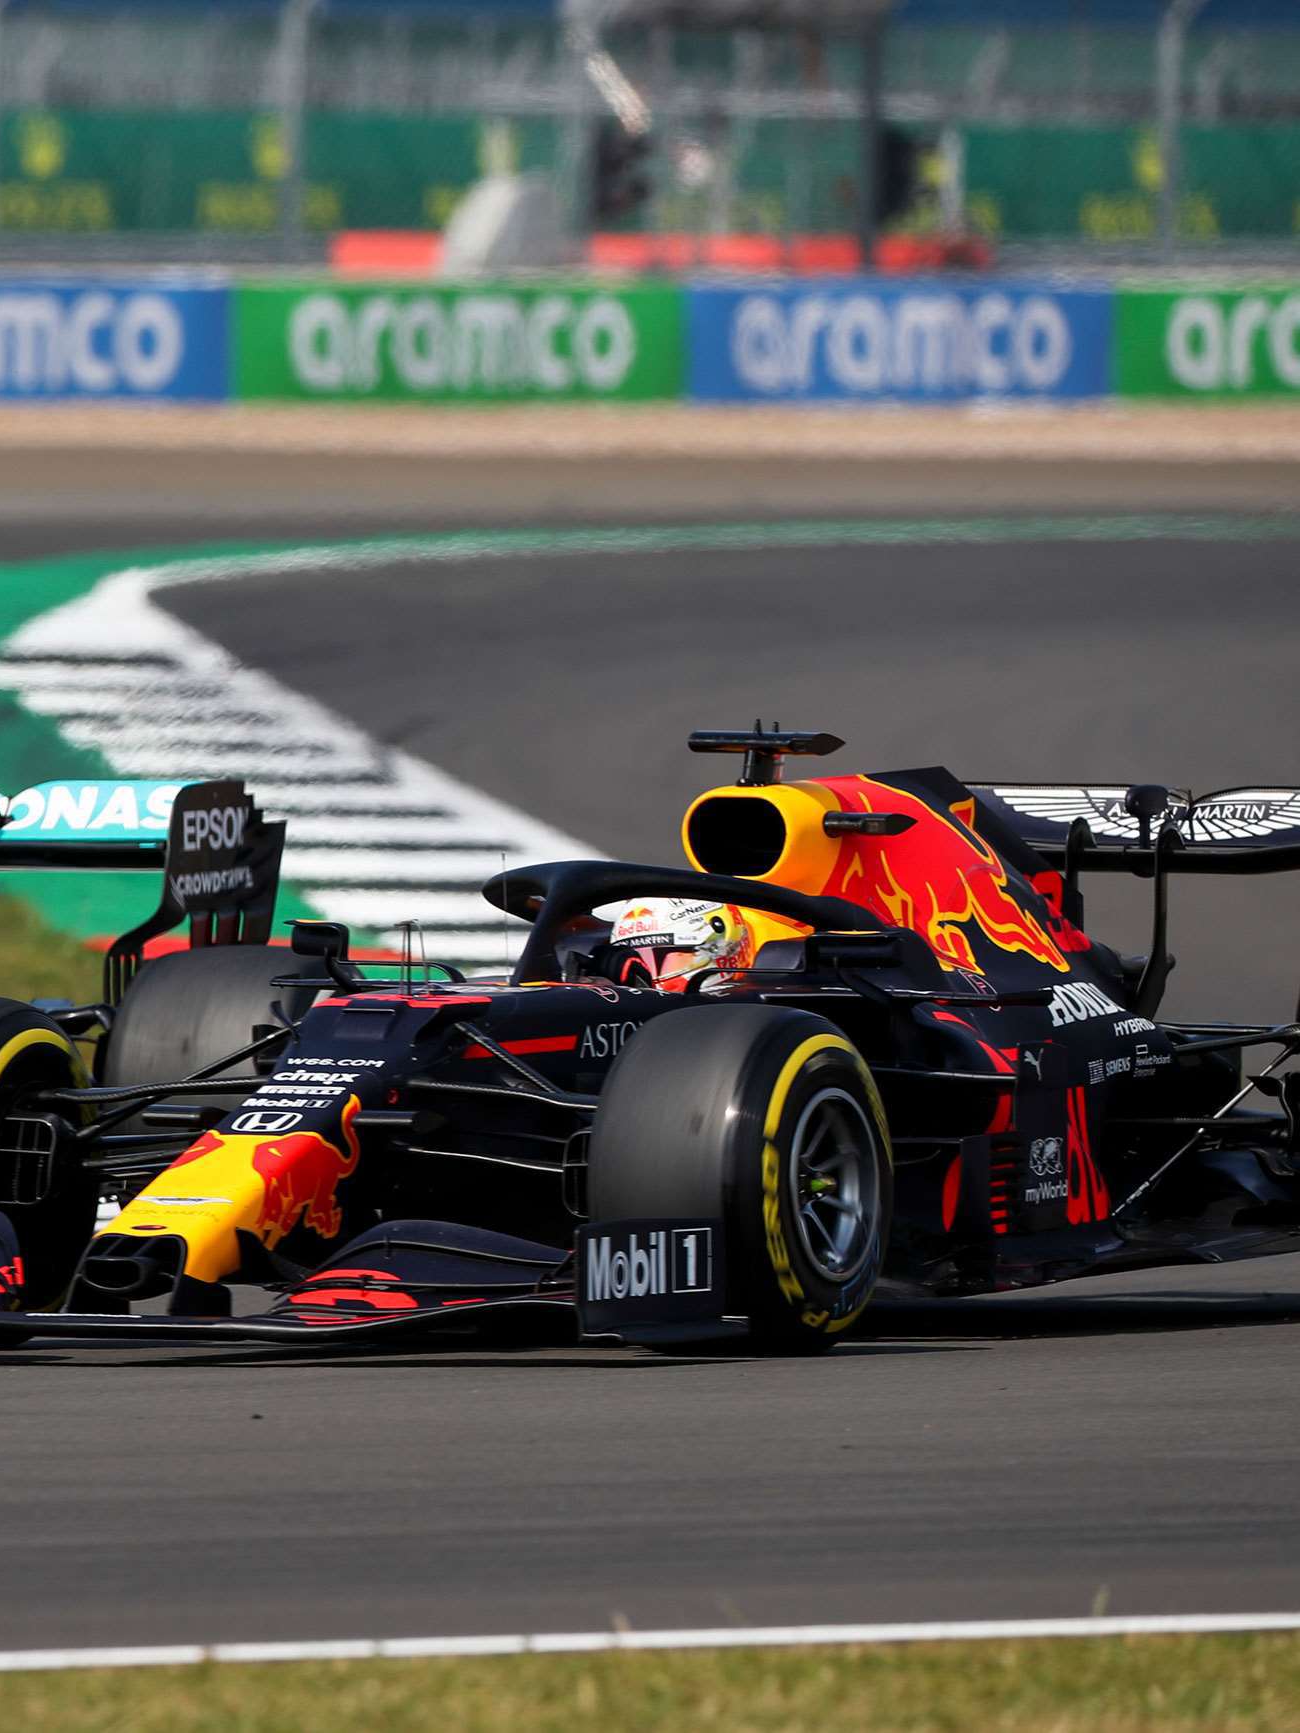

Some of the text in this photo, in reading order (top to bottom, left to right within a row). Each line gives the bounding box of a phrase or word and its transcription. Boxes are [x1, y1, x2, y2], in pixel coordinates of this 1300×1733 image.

[288, 294, 636, 391] aramco
[731, 294, 1070, 391] aramco
[1193, 804, 1266, 820] MARTIN
[183, 806, 249, 852] EPSON
[630, 934, 670, 947] MARTIN
[580, 1021, 644, 1059] ASTO
[1113, 1018, 1156, 1037] HYBRID
[241, 1099, 308, 1108] Mobil
[1025, 1179, 1068, 1205] myWorld
[588, 1231, 698, 1301] Mobil 1
